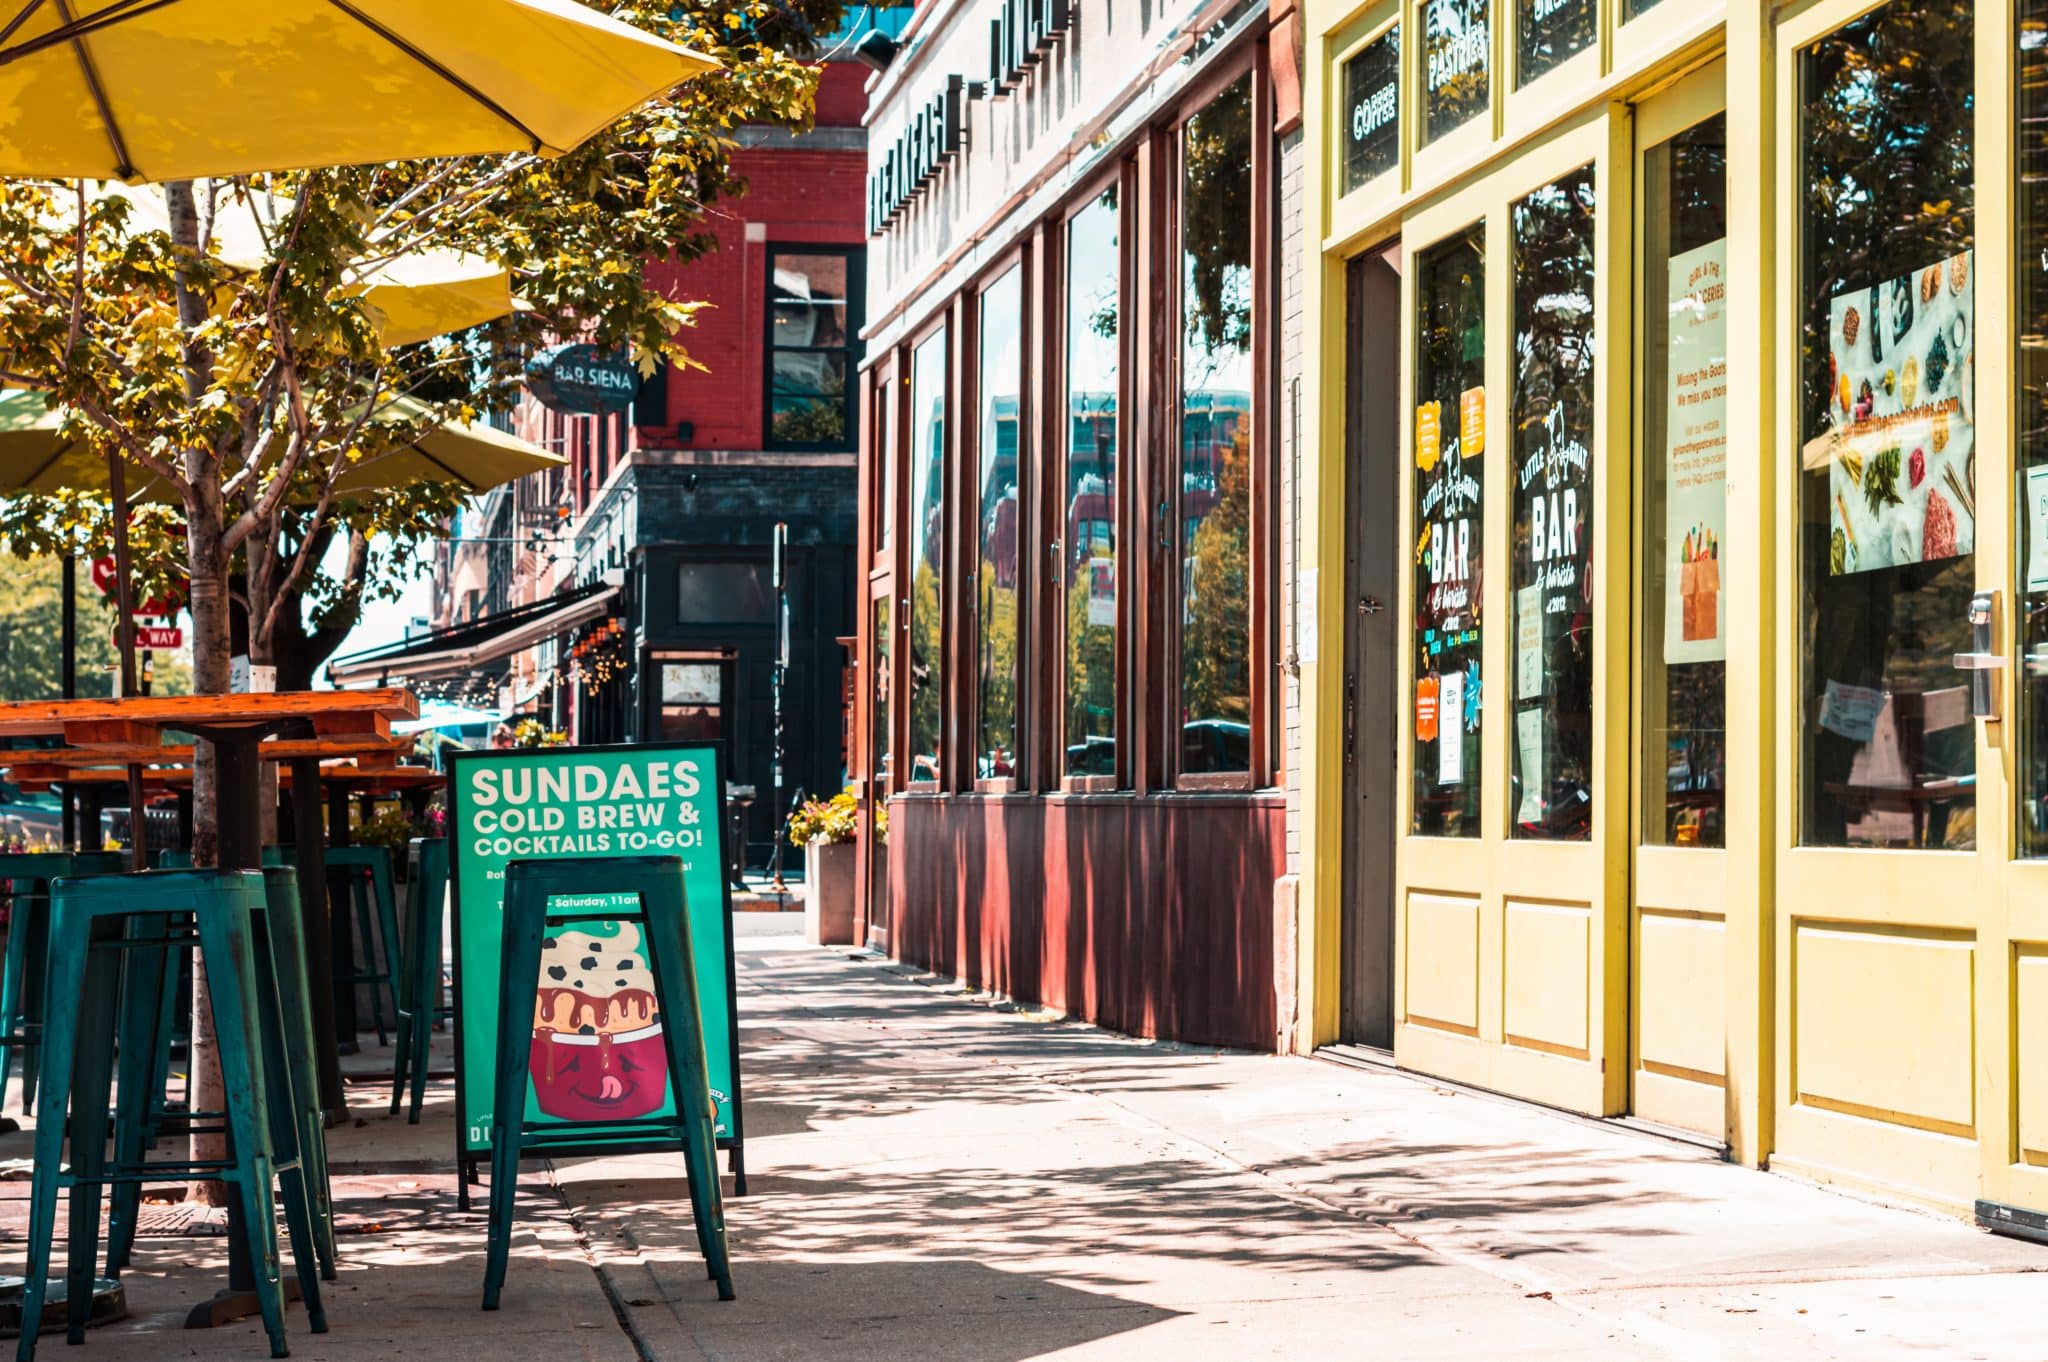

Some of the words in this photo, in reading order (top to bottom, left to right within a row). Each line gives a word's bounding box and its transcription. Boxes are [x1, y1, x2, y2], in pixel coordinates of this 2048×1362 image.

[1429, 20, 1486, 91] PASTRIES
[1353, 81, 1396, 141] COFFEE
[555, 365, 585, 385] BAR
[589, 367, 632, 390] SIENA
[1521, 446, 1544, 490] LITTLE
[1568, 440, 1588, 471] GOAT
[1422, 478, 1443, 517] LITTLE
[1463, 474, 1480, 504] GOAT
[1532, 488, 1577, 562] BAR
[1432, 518, 1469, 584] BAR
[150, 631, 177, 645] WAY
[471, 761, 701, 806] SUNDAES
[473, 808, 565, 834] COLD
[577, 803, 665, 830] BREW
[678, 801, 700, 825] &
[473, 834, 611, 857] COCKTAILS
[617, 829, 703, 850] TO-GO!
[555, 895, 608, 909] Saturday,
